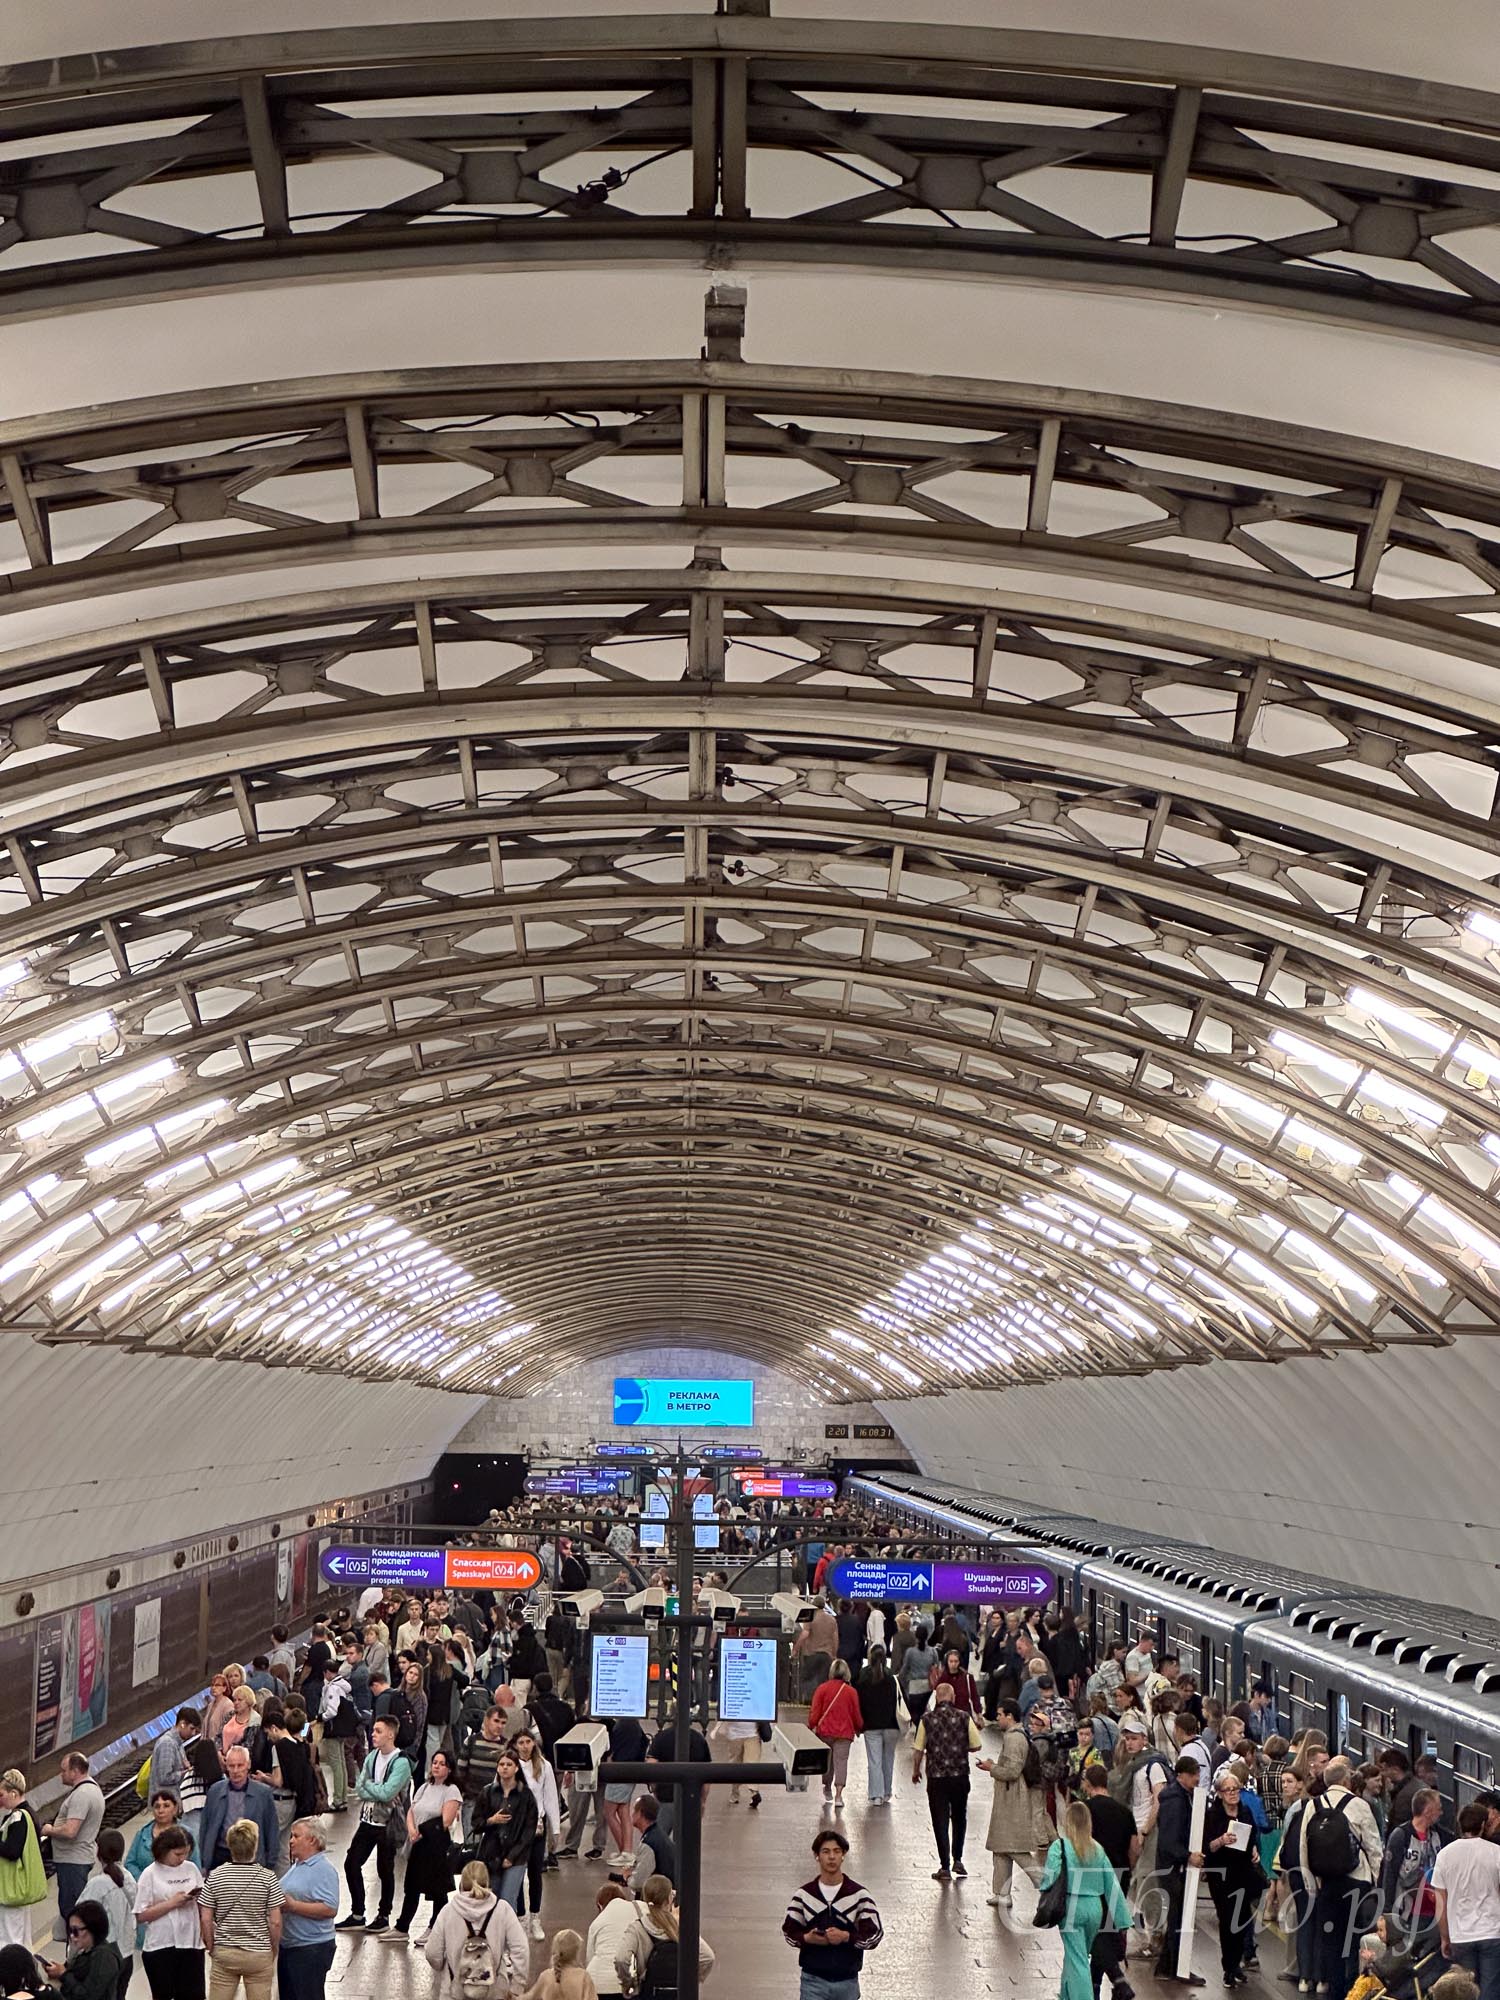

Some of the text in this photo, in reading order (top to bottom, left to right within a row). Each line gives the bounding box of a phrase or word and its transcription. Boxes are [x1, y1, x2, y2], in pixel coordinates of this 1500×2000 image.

[669, 1392, 720, 1400] РЕКЛАМА
[676, 1403, 711, 1411] МЕТРО
[371, 1549, 440, 1558] Комендантский
[371, 1558, 411, 1566] проспект
[452, 1558, 491, 1567] Спасская
[855, 1562, 886, 1570] Сенная
[371, 1568, 429, 1578] Komendantskiy
[452, 1569, 491, 1579] Spasskaya
[847, 1571, 886, 1579] площадь
[370, 1577, 404, 1585] prospekt
[964, 1573, 1003, 1583] Шушары
[853, 1581, 886, 1591] Sennaya
[967, 1584, 1003, 1594] Shushary
[850, 1589, 886, 1598] ploschad'
